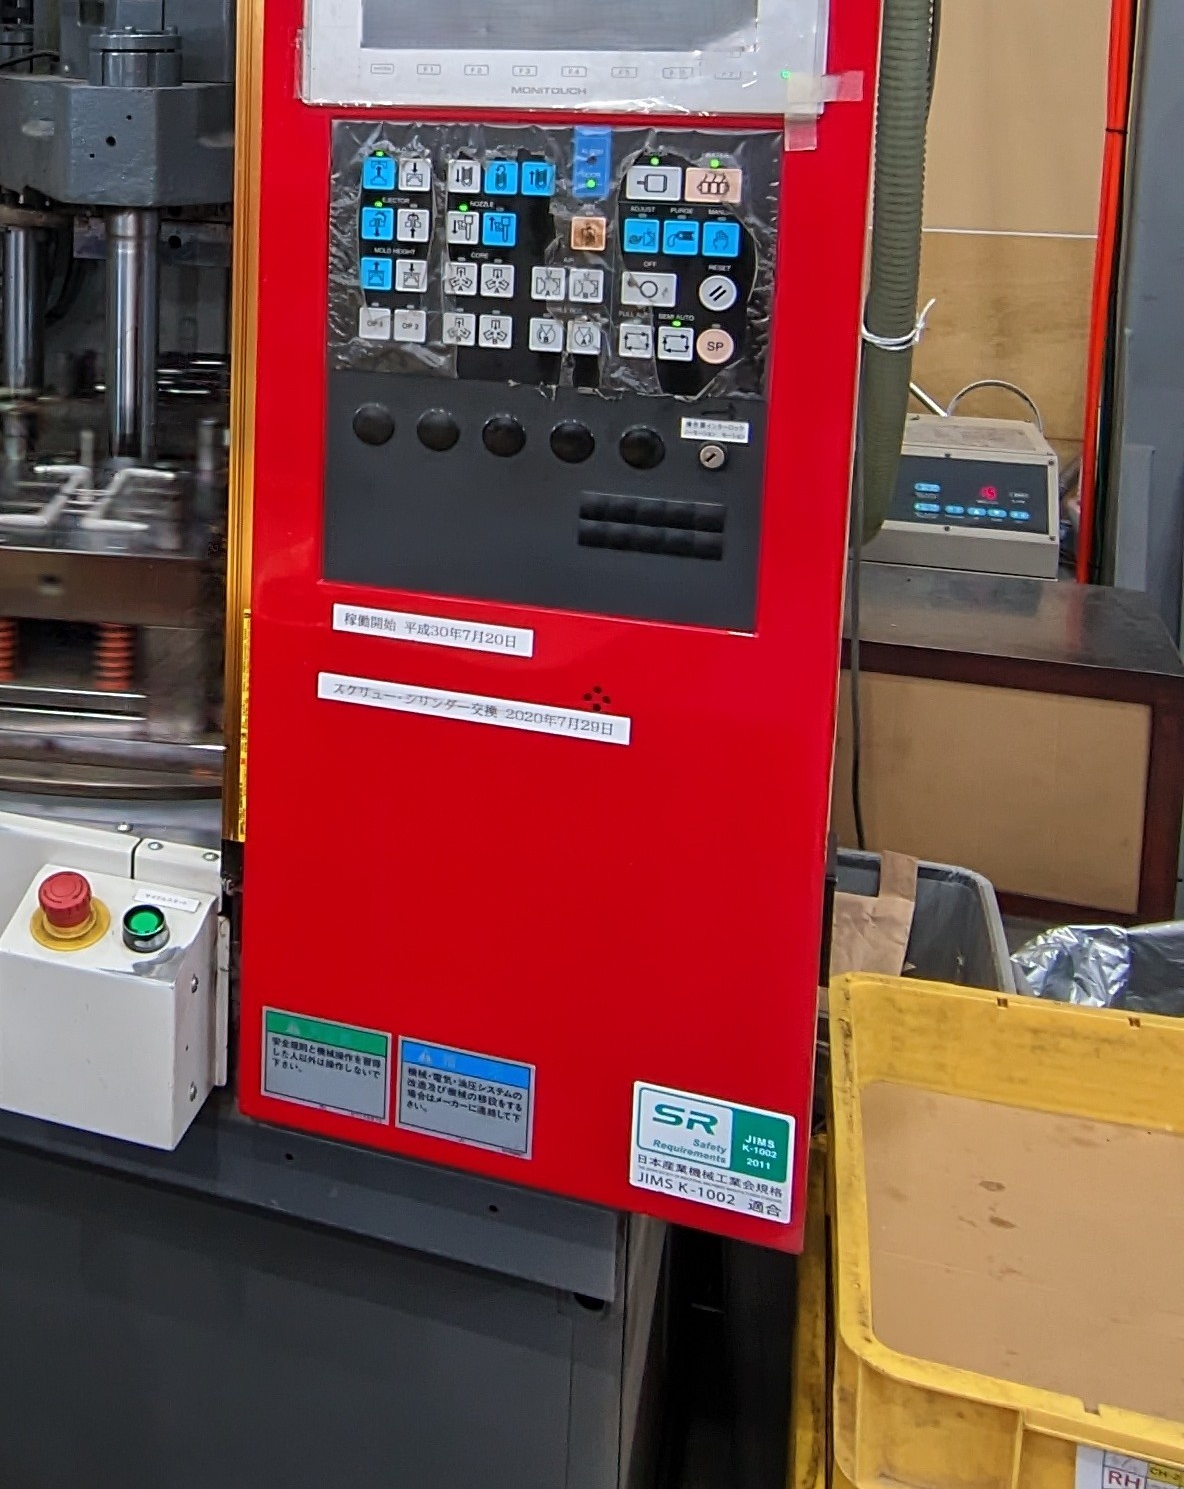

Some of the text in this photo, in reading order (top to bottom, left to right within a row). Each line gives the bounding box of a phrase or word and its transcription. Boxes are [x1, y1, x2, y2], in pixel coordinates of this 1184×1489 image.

[510, 86, 587, 96] MONITOUCH
[708, 264, 732, 272] RESET
[707, 341, 724, 352] SP
[344, 612, 517, 649] 稼働開始 平成30年7月20日
[333, 682, 614, 737] スクリュー・シリンダー交換 2020年7月29日
[652, 1103, 718, 1136] SR
[692, 1138, 727, 1155] Safety
[745, 1135, 775, 1149] JIMS
[652, 1139, 727, 1164] Requirements
[742, 1144, 778, 1159] K-1002
[746, 1158, 771, 1170] 2011
[637, 1154, 783, 1199] 日本産業機械工業会規格
[637, 1172, 674, 1190] JIMS
[748, 1198, 782, 1218] 適合
[1108, 1470, 1141, 1489] RH
